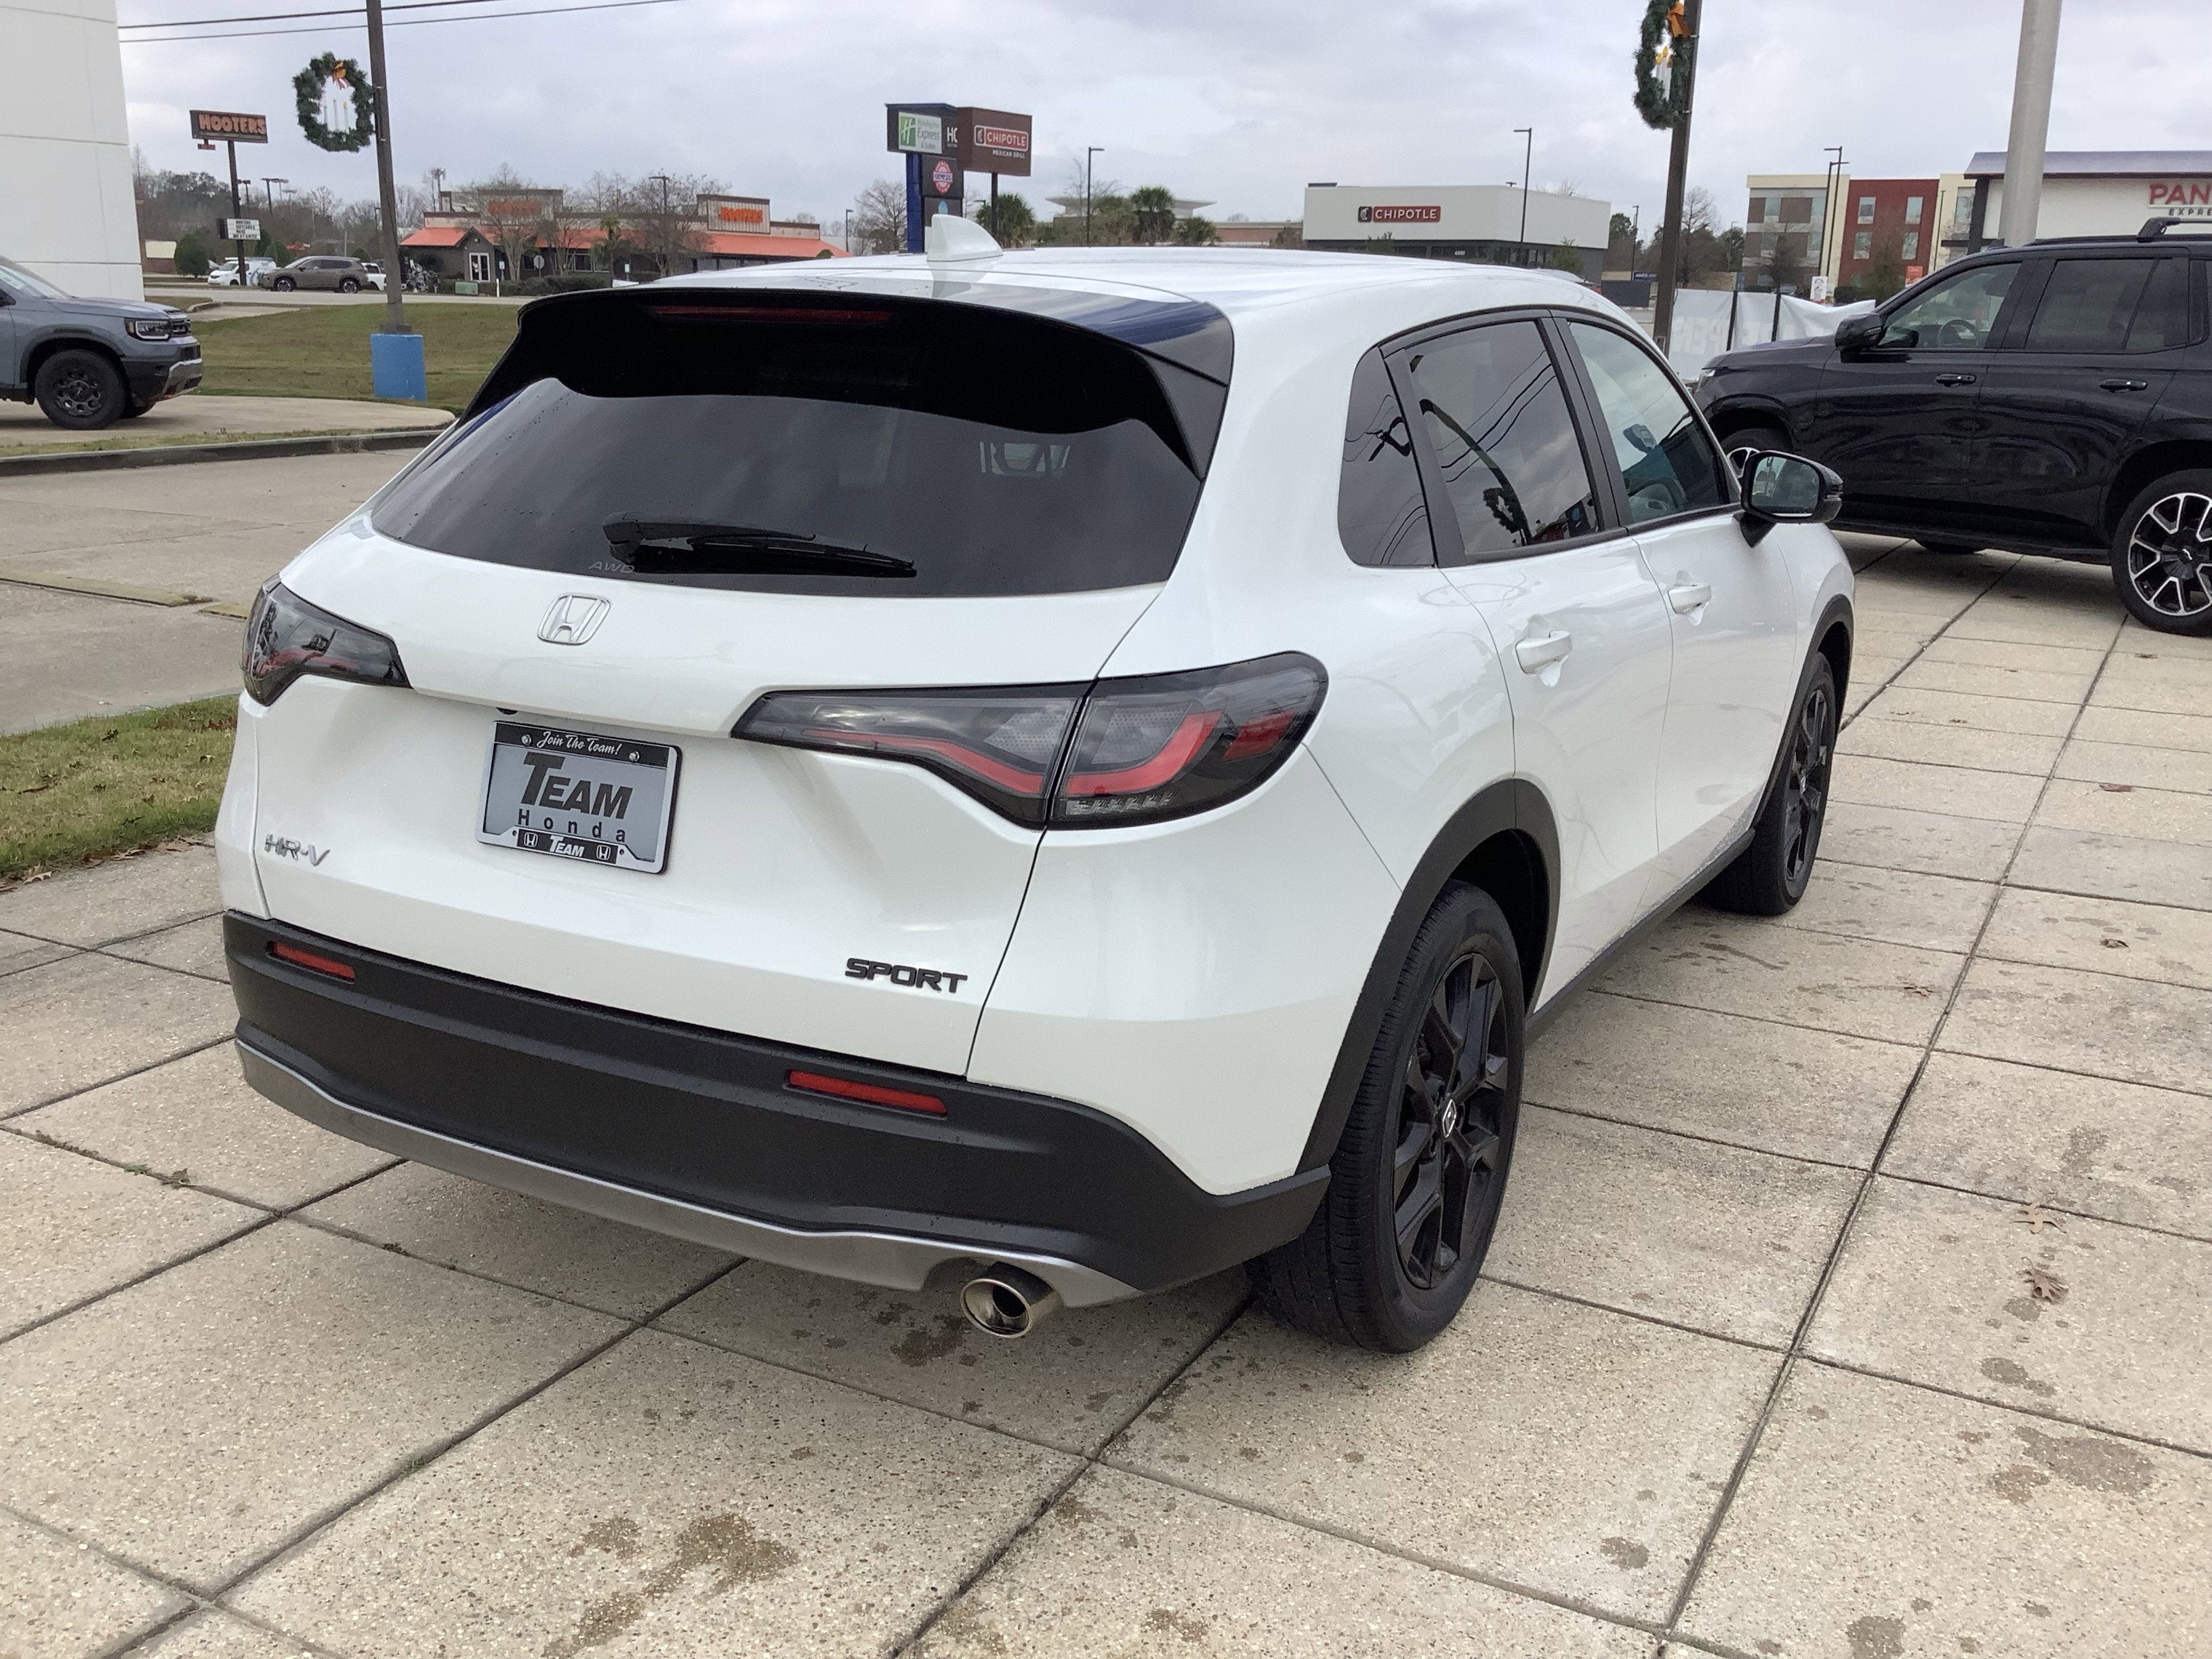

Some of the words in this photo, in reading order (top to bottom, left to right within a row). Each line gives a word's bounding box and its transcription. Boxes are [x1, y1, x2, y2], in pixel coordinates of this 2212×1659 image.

[199, 113, 266, 135] HOOTERS
[917, 127, 940, 141] Express
[987, 131, 1026, 147] CHIPOTLE
[992, 149, 1012, 158] MEXICAN
[1375, 209, 1437, 220] CHIPOTLE
[588, 561, 635, 573] AWD
[537, 731, 564, 748] Join
[565, 734, 586, 750] The
[587, 737, 622, 755] Team!
[520, 751, 634, 820] TEAM
[518, 808, 626, 842] Honda
[264, 834, 331, 866] HR-V
[549, 835, 585, 857] TEAM
[844, 957, 968, 994] SPORT
